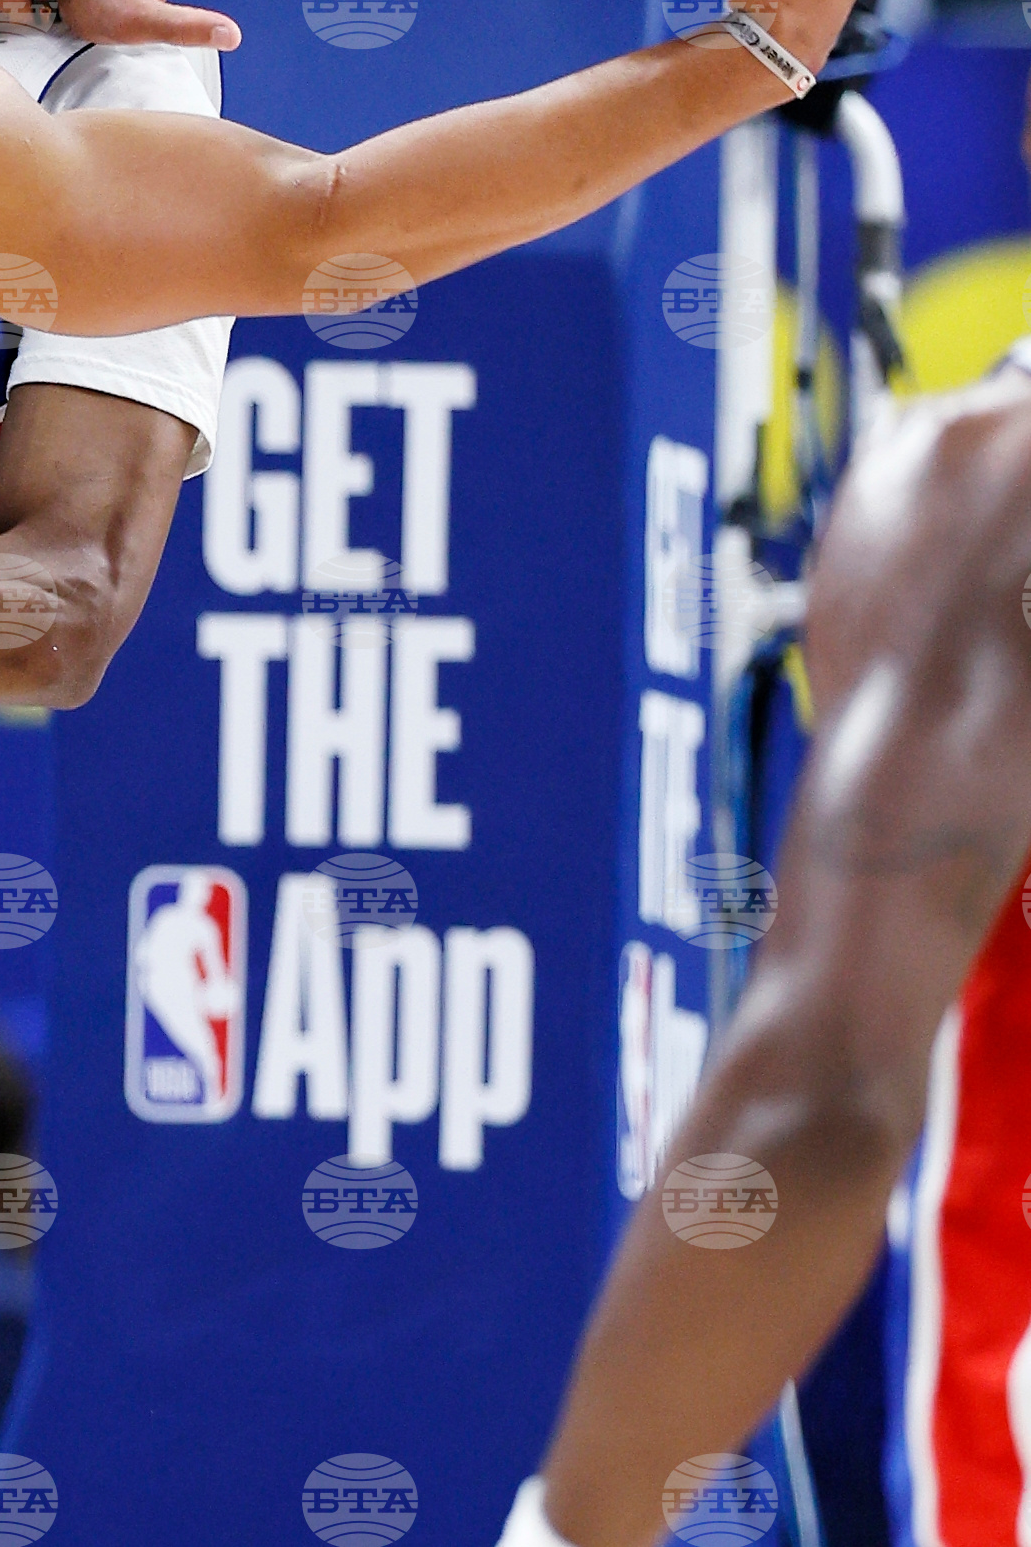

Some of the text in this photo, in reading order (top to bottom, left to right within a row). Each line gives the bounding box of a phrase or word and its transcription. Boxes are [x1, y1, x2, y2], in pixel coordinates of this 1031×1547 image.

[201, 355, 478, 597] GET
[196, 609, 476, 851] THE
[251, 872, 536, 1171] App
